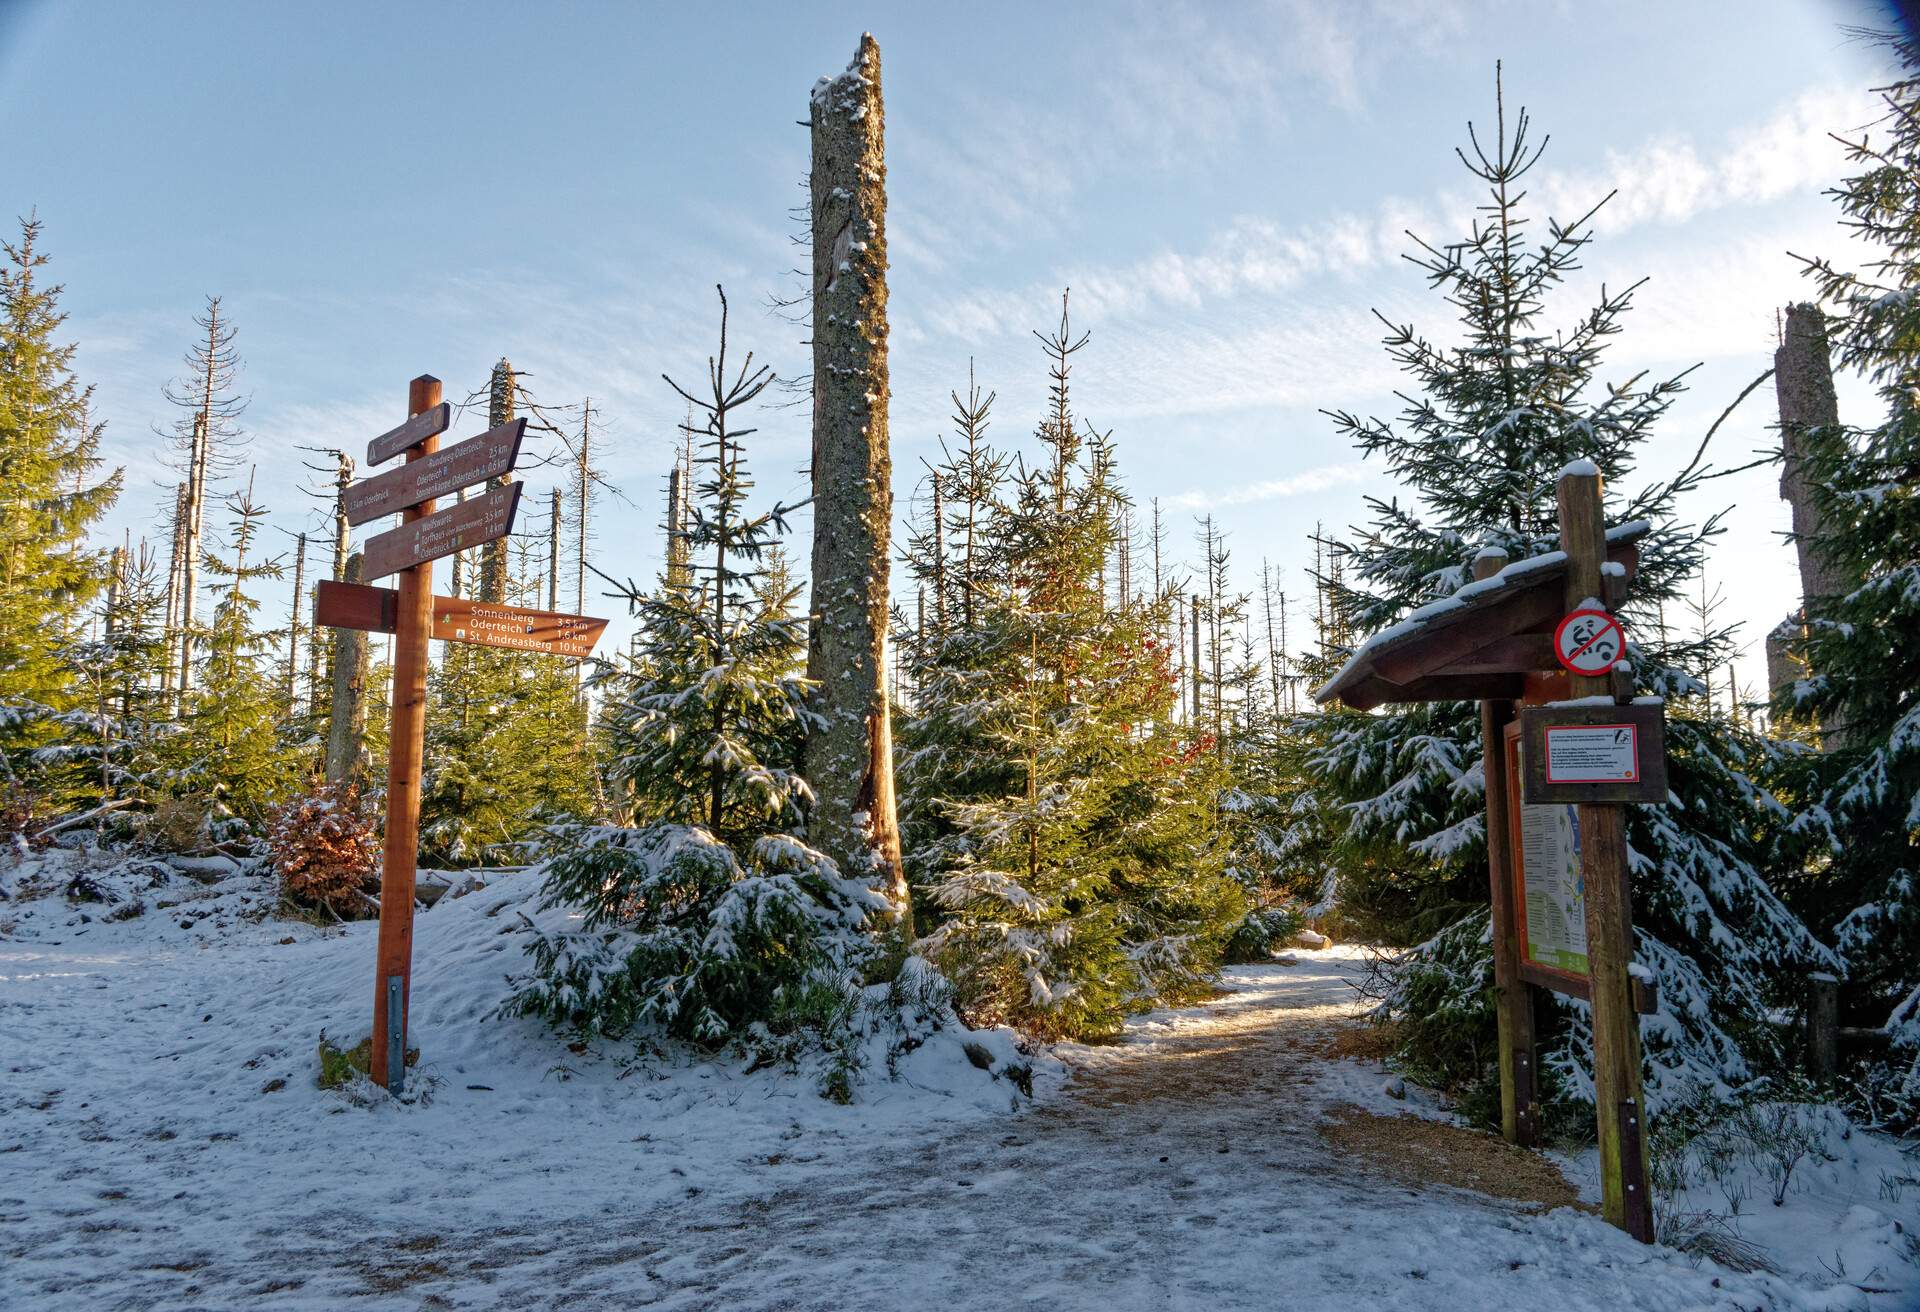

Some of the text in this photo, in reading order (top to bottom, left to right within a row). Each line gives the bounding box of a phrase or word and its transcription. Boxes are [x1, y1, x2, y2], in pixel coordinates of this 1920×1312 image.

[498, 444, 509, 454] km
[452, 468, 480, 485] Oderteich
[497, 458, 507, 470] km
[490, 497, 494, 506] 4
[494, 494, 504, 505] km
[421, 529, 445, 545] Torfhaus
[494, 508, 504, 519] km
[494, 523, 504, 535] km
[470, 618, 522, 634] Oderteich
[572, 631, 588, 641] km
[471, 606, 534, 625] Sonnenberg
[573, 619, 588, 630] km
[469, 630, 587, 653] St. Andreasberg 10 km
